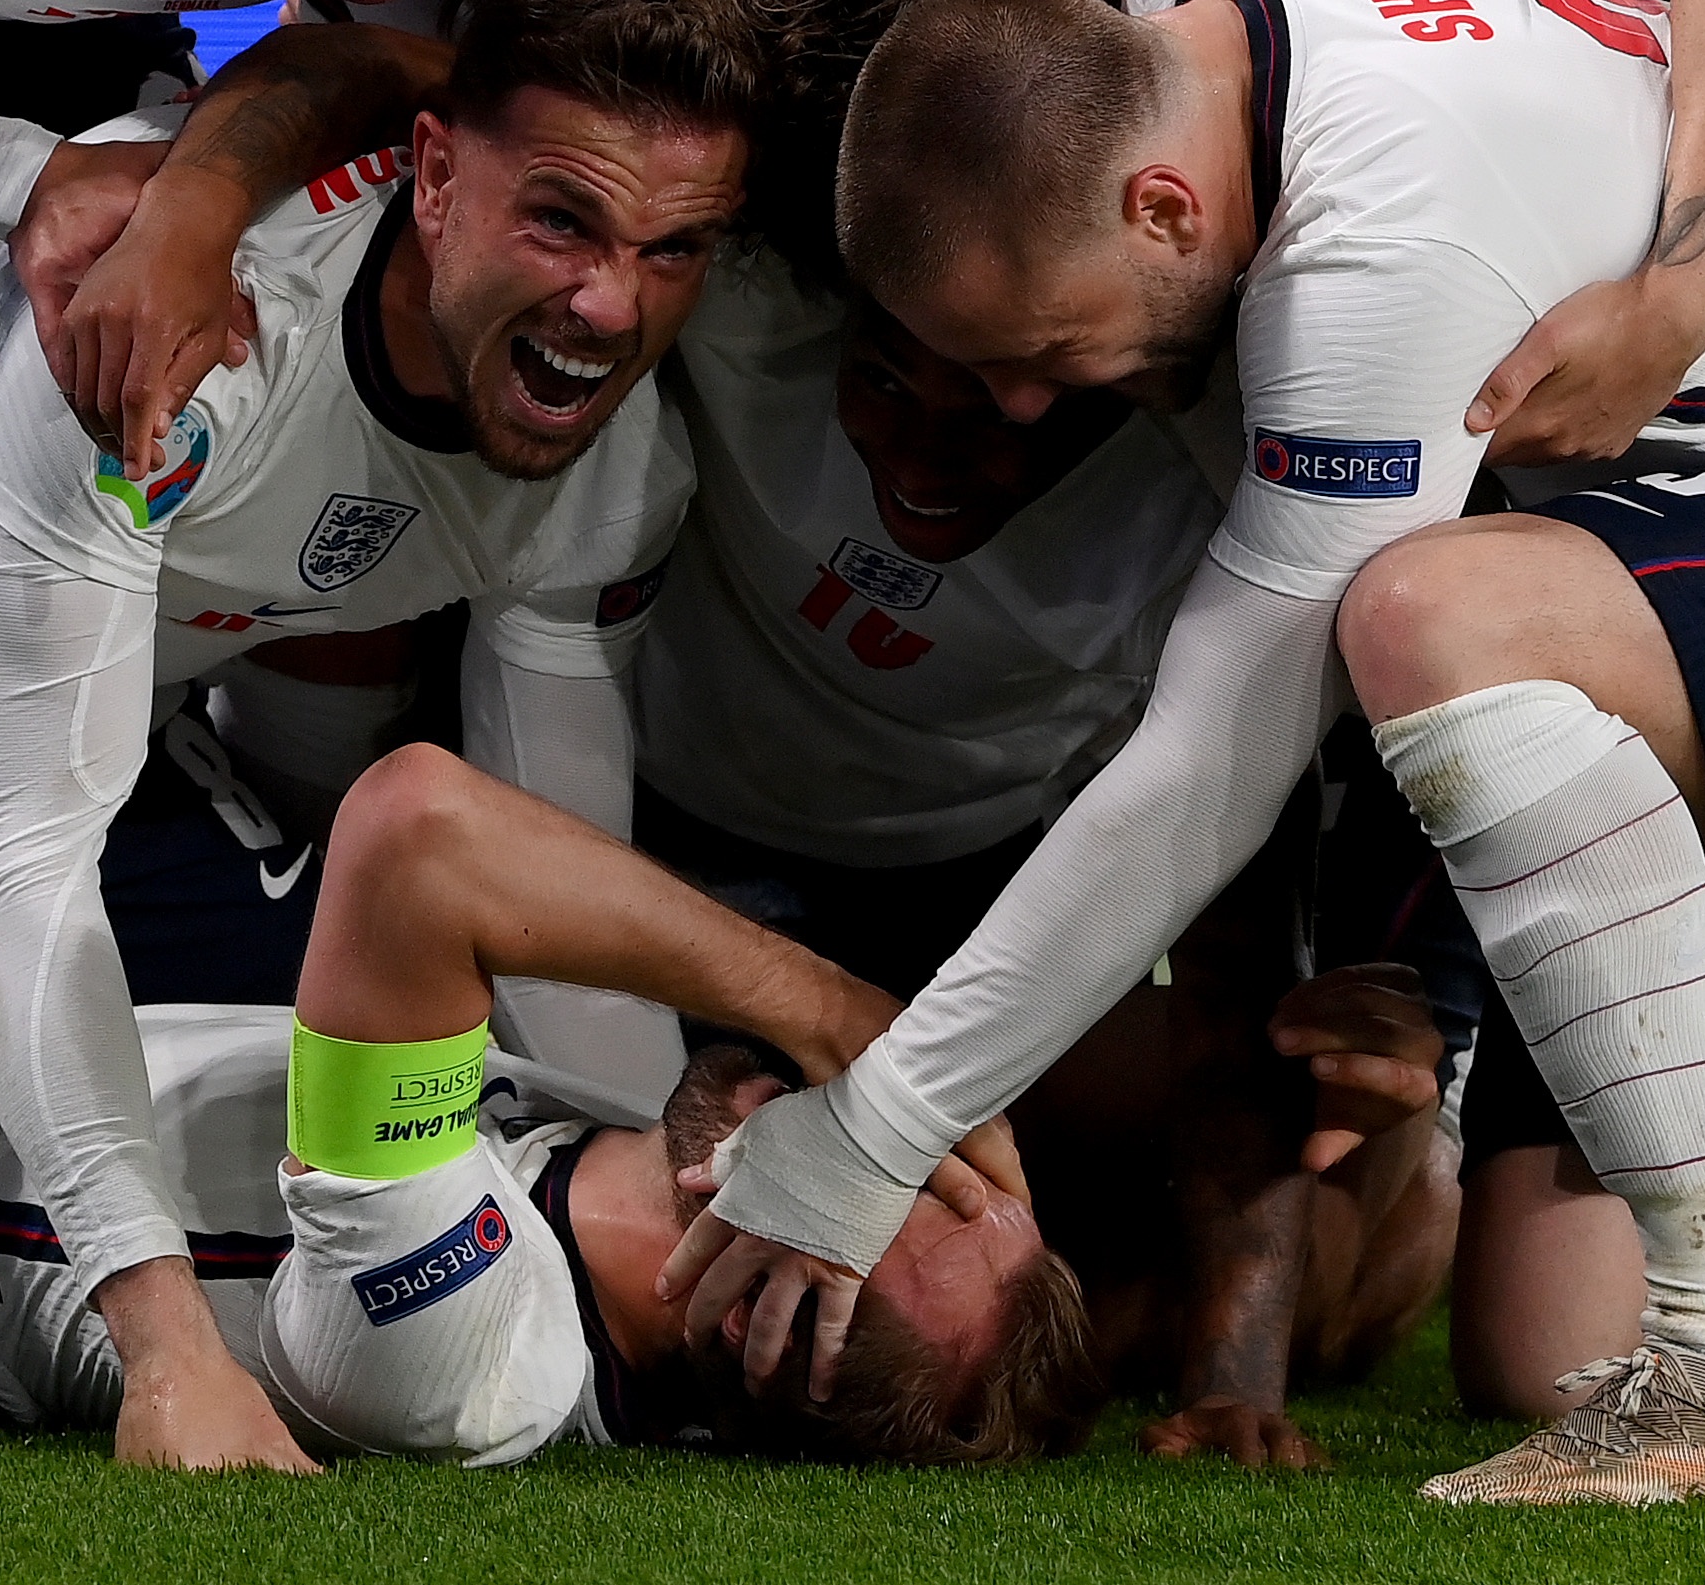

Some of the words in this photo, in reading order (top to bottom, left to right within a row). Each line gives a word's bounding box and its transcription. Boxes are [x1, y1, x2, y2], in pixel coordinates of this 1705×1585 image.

[1294, 453, 1418, 482] RESPECT
[390, 1060, 482, 1102] RESPECT
[373, 1114, 444, 1143] GAME
[364, 1238, 478, 1312] RESPECT
